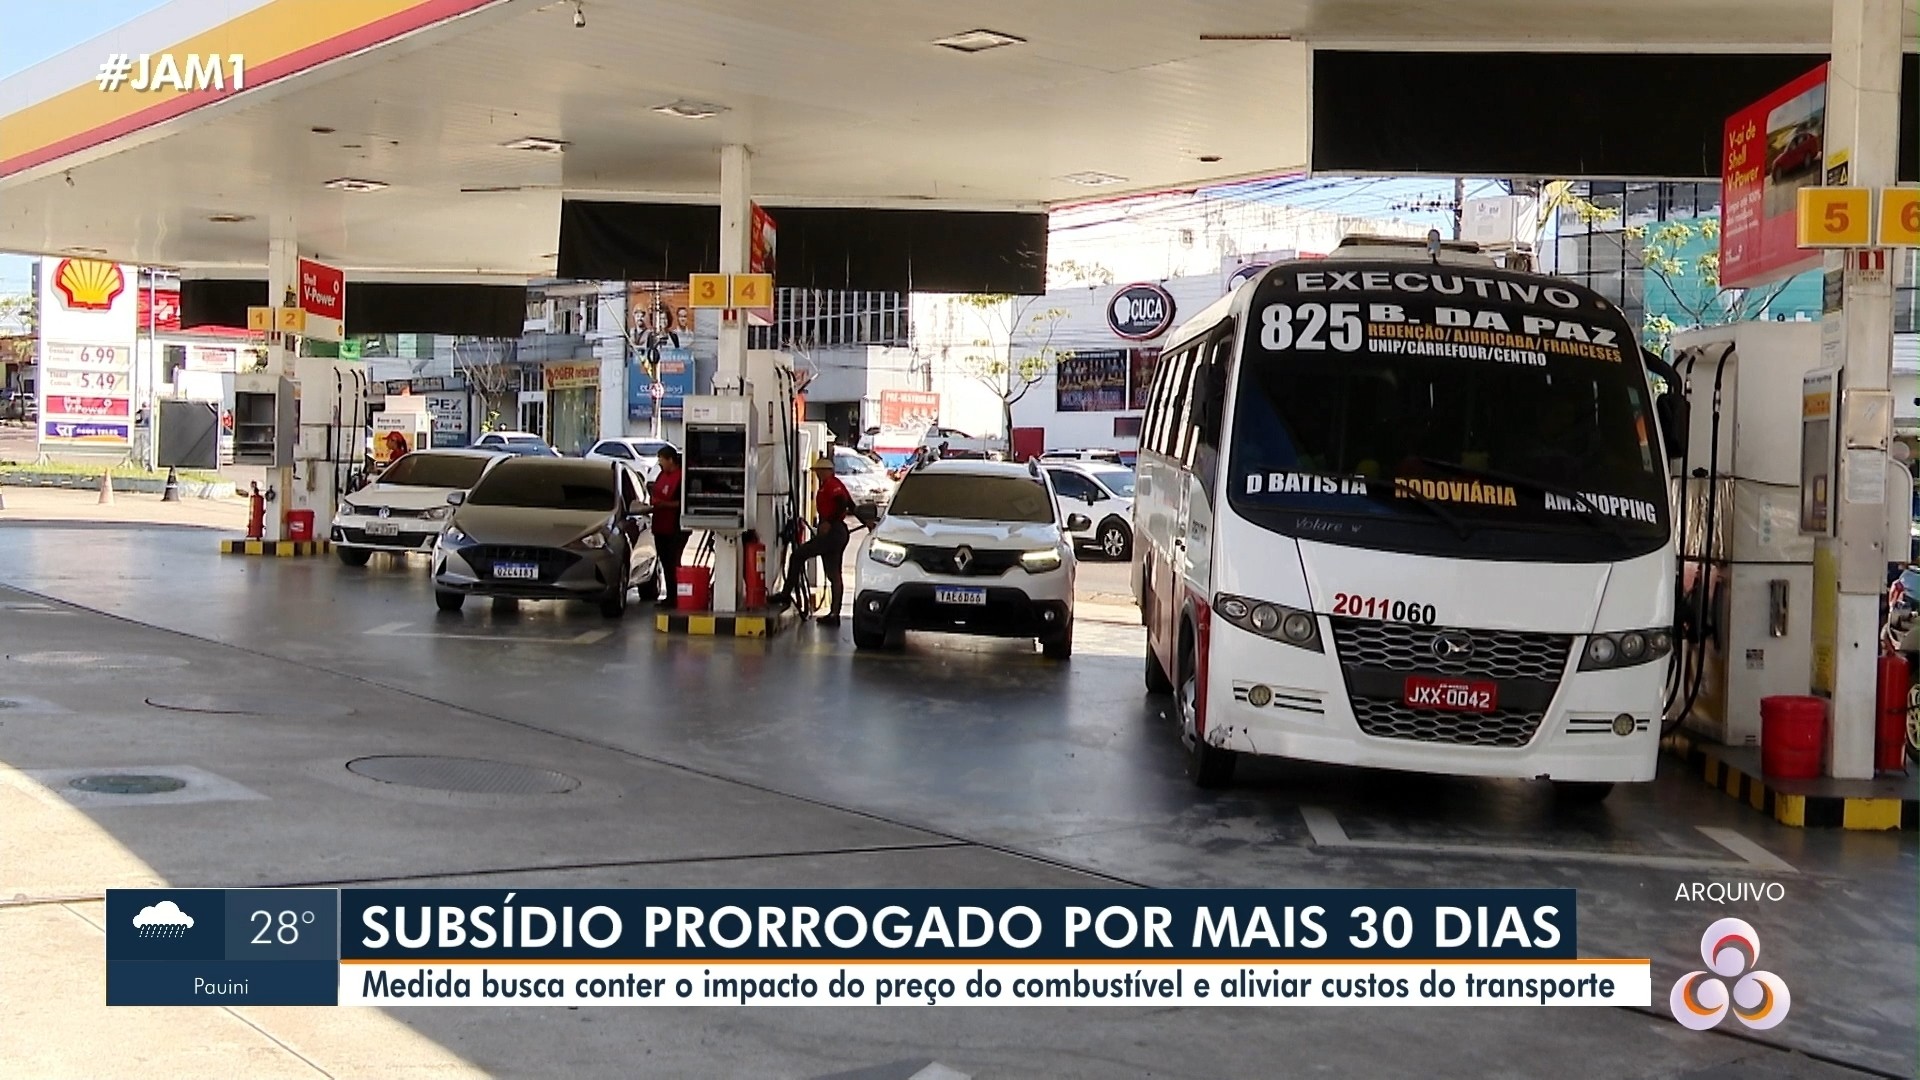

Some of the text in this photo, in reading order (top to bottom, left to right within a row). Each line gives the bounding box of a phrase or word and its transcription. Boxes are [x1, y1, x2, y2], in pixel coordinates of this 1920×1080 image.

[1824, 203, 1850, 234] 5
[1901, 201, 1920, 233] 6
[304, 285, 336, 307] V-Power
[701, 281, 715, 299] 3
[741, 282, 757, 300] 4
[1297, 271, 1580, 308] EXECUTIVO
[255, 312, 264, 325] 1
[286, 313, 296, 326] 2
[1131, 297, 1163, 320] CUCA
[1260, 303, 1363, 351] 825
[1369, 303, 1619, 348] B. DA PAZ
[81, 346, 115, 364] 6.99
[1368, 338, 1548, 367] UNIP/CARREFOUR/CENTRO
[81, 372, 115, 389] 5.49
[1268, 473, 1368, 496] BATISTA
[1395, 477, 1517, 506] RODOVIÁRIA
[1333, 593, 1436, 625] 2011060
